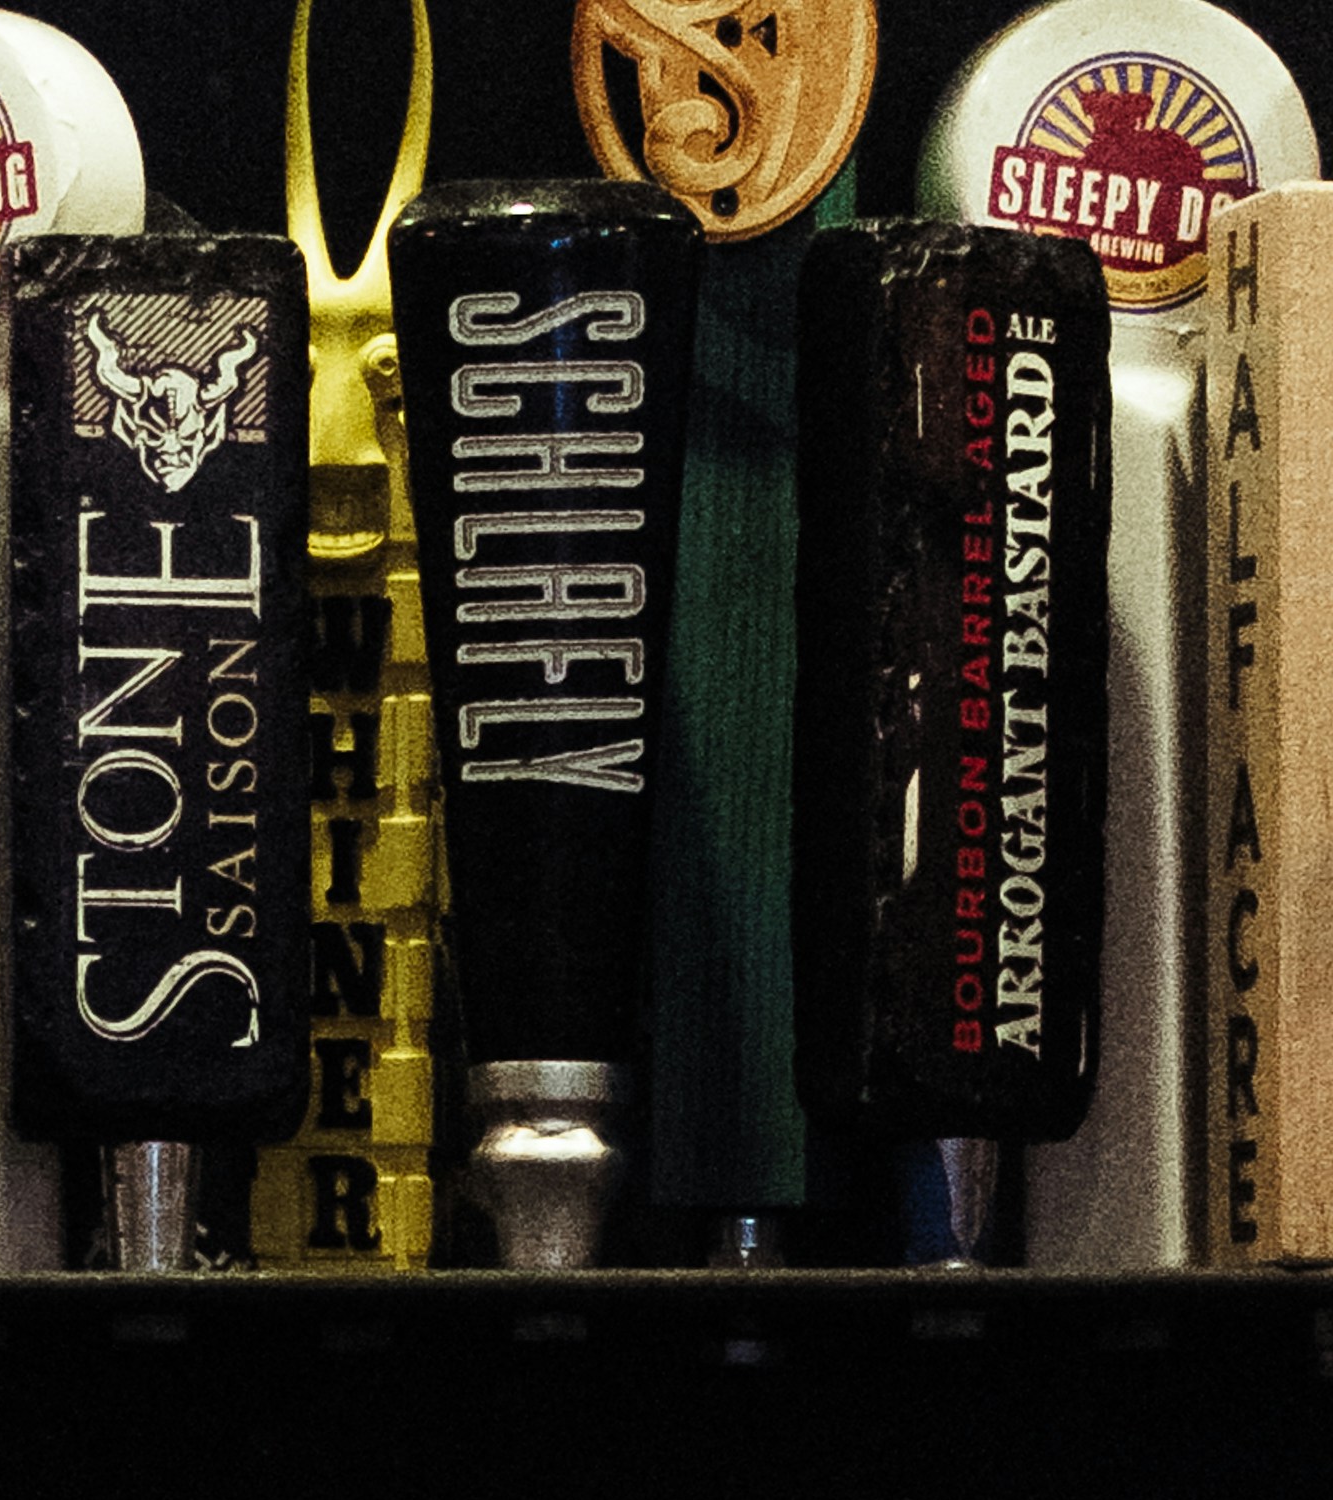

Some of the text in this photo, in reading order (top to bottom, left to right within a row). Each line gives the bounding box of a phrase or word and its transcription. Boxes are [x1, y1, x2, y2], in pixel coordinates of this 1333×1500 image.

[998, 162, 1156, 235] SLEEPY
[1006, 311, 1057, 345] ALE
[76, 511, 262, 1048] STONE
[207, 638, 259, 939] SAISON
[448, 290, 649, 795] SCHLAFLY
[994, 350, 1057, 1061] ARROGANT BASTARD
[1224, 222, 1262, 1244] HALF ACRE
[308, 595, 391, 1249] WHINER
[953, 754, 992, 1053] BOURBON
